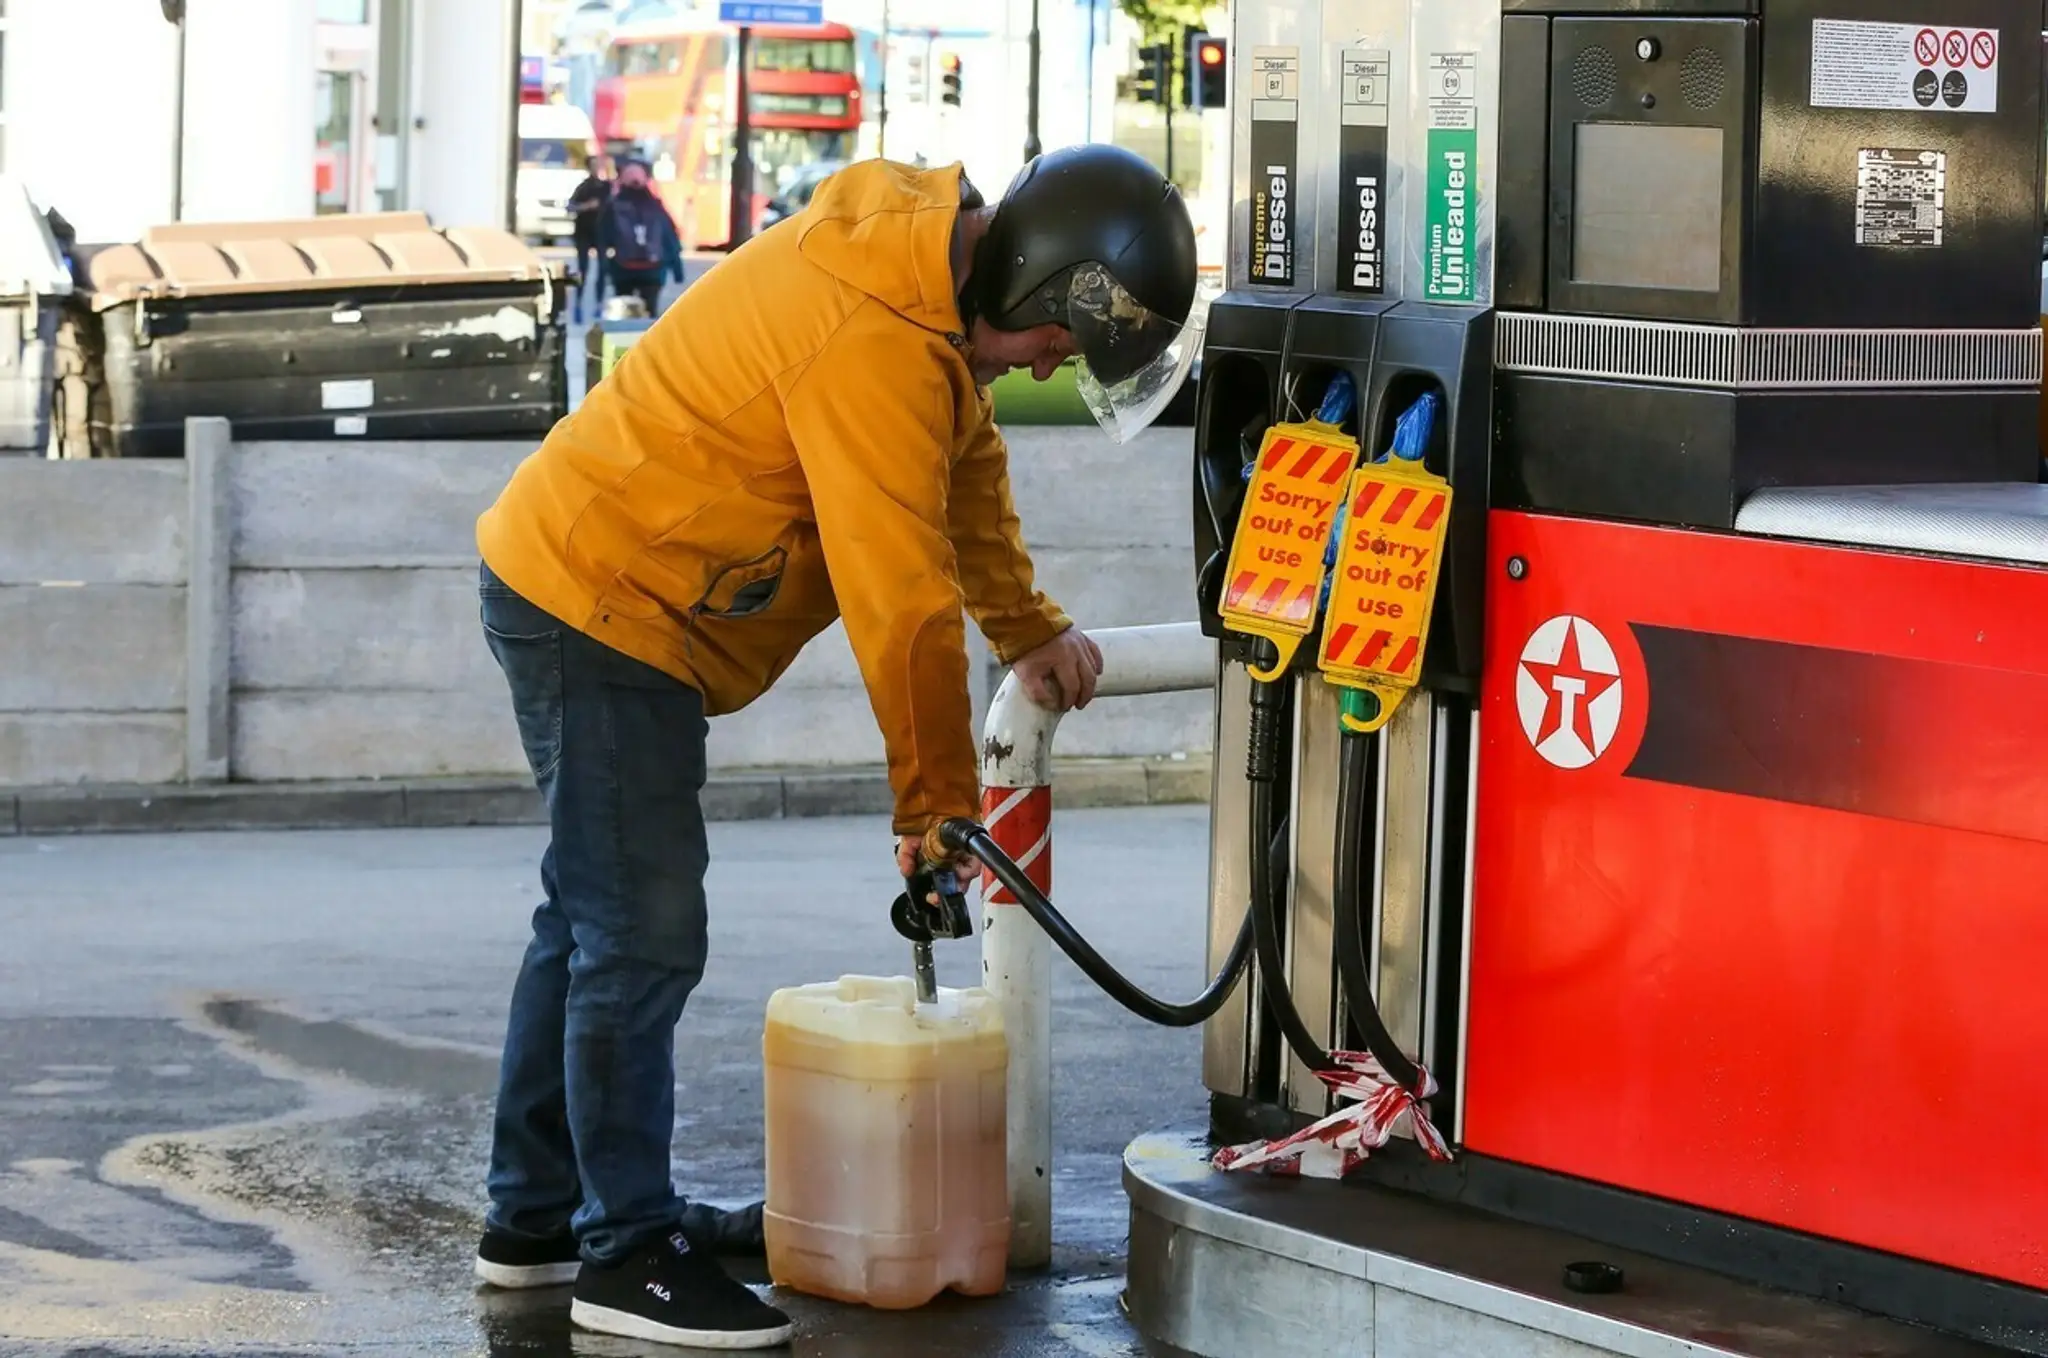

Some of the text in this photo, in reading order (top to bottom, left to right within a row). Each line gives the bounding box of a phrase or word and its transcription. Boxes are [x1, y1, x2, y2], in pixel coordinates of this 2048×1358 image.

[1263, 60, 1287, 69] Diesel
[1353, 64, 1377, 73] Diesel
[1270, 81, 1280, 90] B7
[1360, 85, 1370, 94] B7
[1445, 78, 1458, 88] E10
[1252, 191, 1266, 277] Supreme
[1265, 165, 1287, 279] Diesel
[1353, 176, 1377, 287] Diesel
[1442, 151, 1466, 296] Unleaded
[1429, 224, 1443, 294] Premium
[1259, 482, 1332, 519] Sorry
[1250, 514, 1327, 542] out of
[1258, 545, 1302, 567] use
[1354, 529, 1430, 568] Sorry
[1347, 564, 1427, 592] out of
[1357, 596, 1404, 619] use
[646, 1282, 671, 1302] FILA
